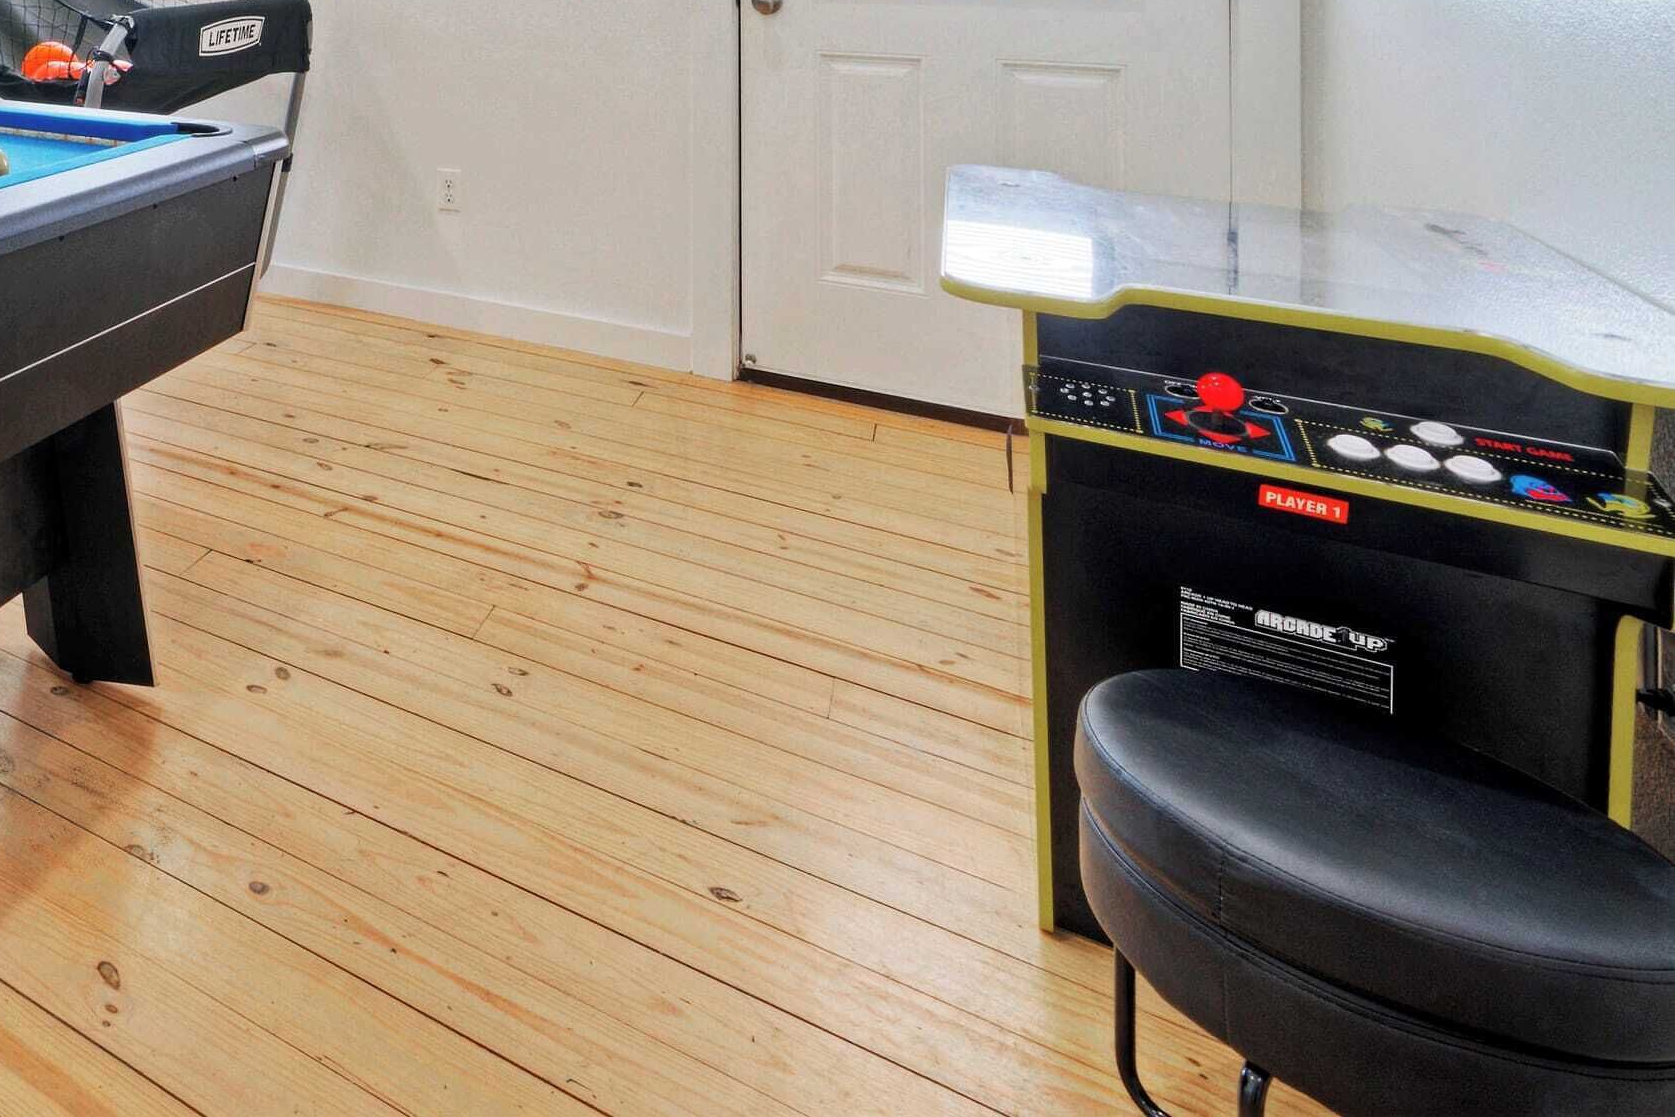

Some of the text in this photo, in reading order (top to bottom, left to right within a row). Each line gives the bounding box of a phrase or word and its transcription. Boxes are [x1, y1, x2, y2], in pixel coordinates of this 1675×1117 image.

[209, 24, 256, 46] LIFETIME
[1199, 439, 1248, 453] MOVE
[1476, 437, 1574, 462] START GAME
[1265, 491, 1341, 519] PLAYER 1
